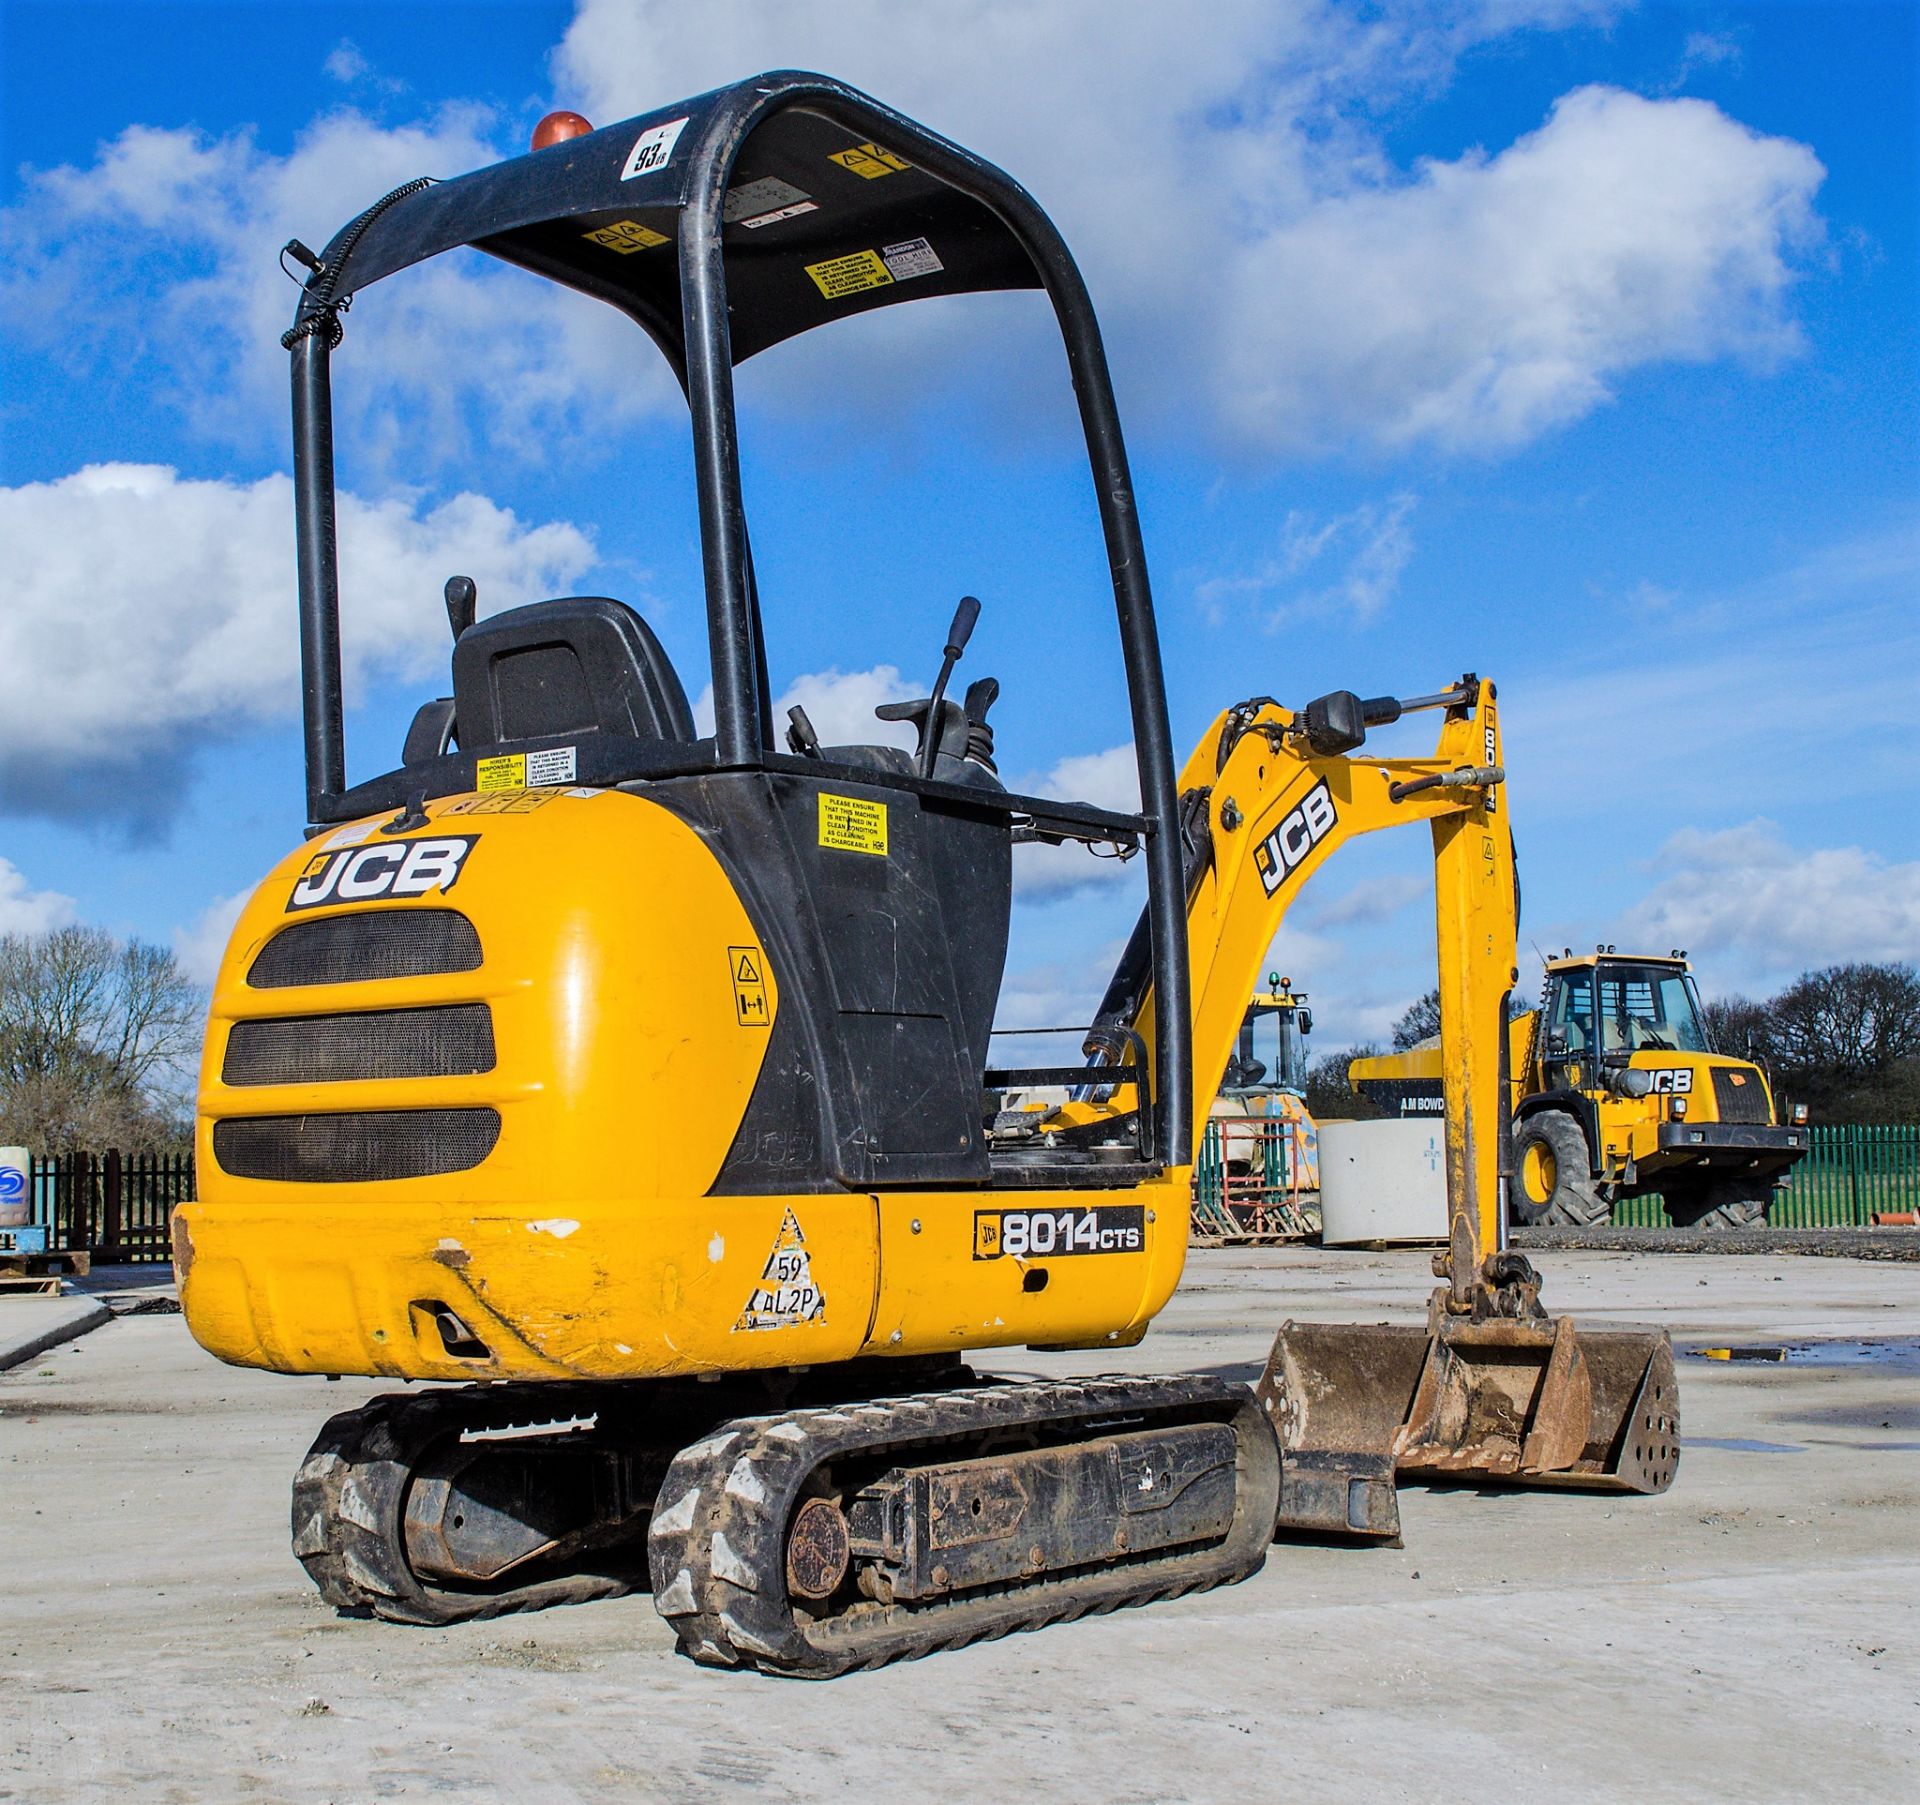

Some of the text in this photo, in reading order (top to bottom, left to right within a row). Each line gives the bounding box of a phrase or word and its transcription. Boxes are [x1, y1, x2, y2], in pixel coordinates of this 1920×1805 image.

[479, 762, 523, 773] RESPONSIBILITY
[824, 805, 880, 820] THAT THIS MACHINE
[829, 798, 875, 812] PLEASE ENSURE
[827, 821, 846, 830] CLEAN
[837, 830, 865, 841] CLEANING
[1263, 785, 1335, 891] JCB
[831, 838, 868, 849] CHARGEABLE
[293, 839, 468, 905] JCB
[1648, 1069, 1692, 1093] JCB
[983, 1225, 997, 1244] JCB
[777, 1255, 802, 1282] 59
